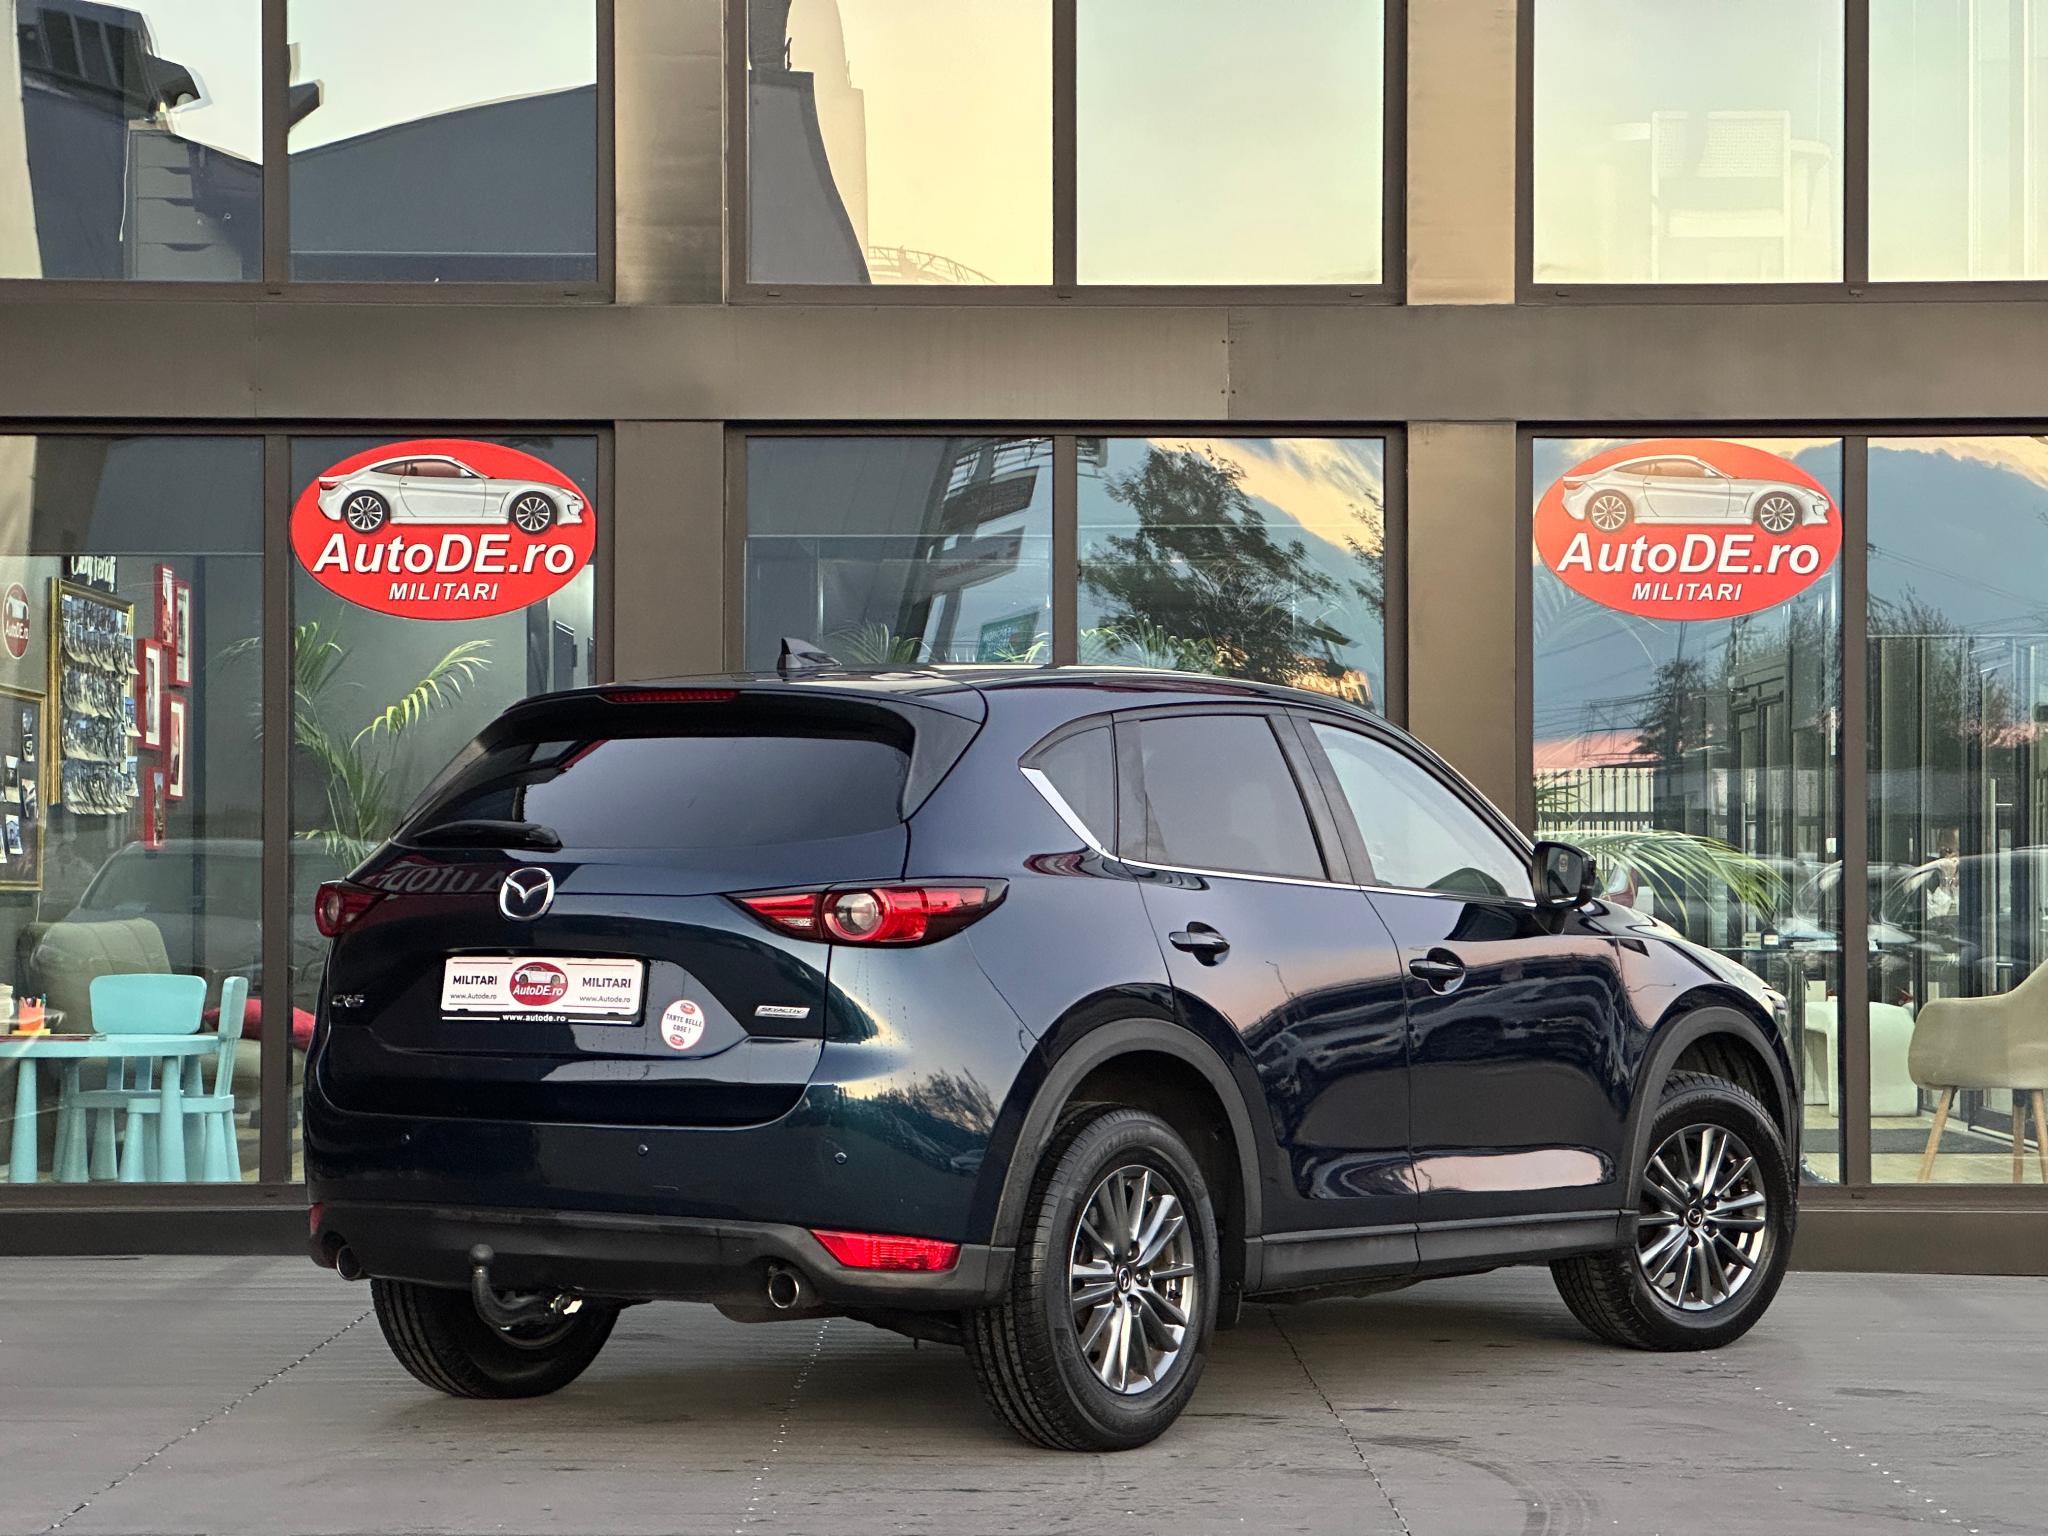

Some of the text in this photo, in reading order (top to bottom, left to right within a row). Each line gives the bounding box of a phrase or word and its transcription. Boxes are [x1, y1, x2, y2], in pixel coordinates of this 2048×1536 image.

[312, 532, 576, 574] AutoDE.ro
[1556, 532, 1820, 574] AutoDE.ro
[388, 582, 499, 601] MILITARI
[1631, 582, 1743, 601] MILITARI
[452, 975, 498, 986] MILITARI
[582, 977, 632, 989] MILITARI
[512, 984, 564, 997] AutoDE.ro
[502, 1013, 567, 1023] www.autode.ro
